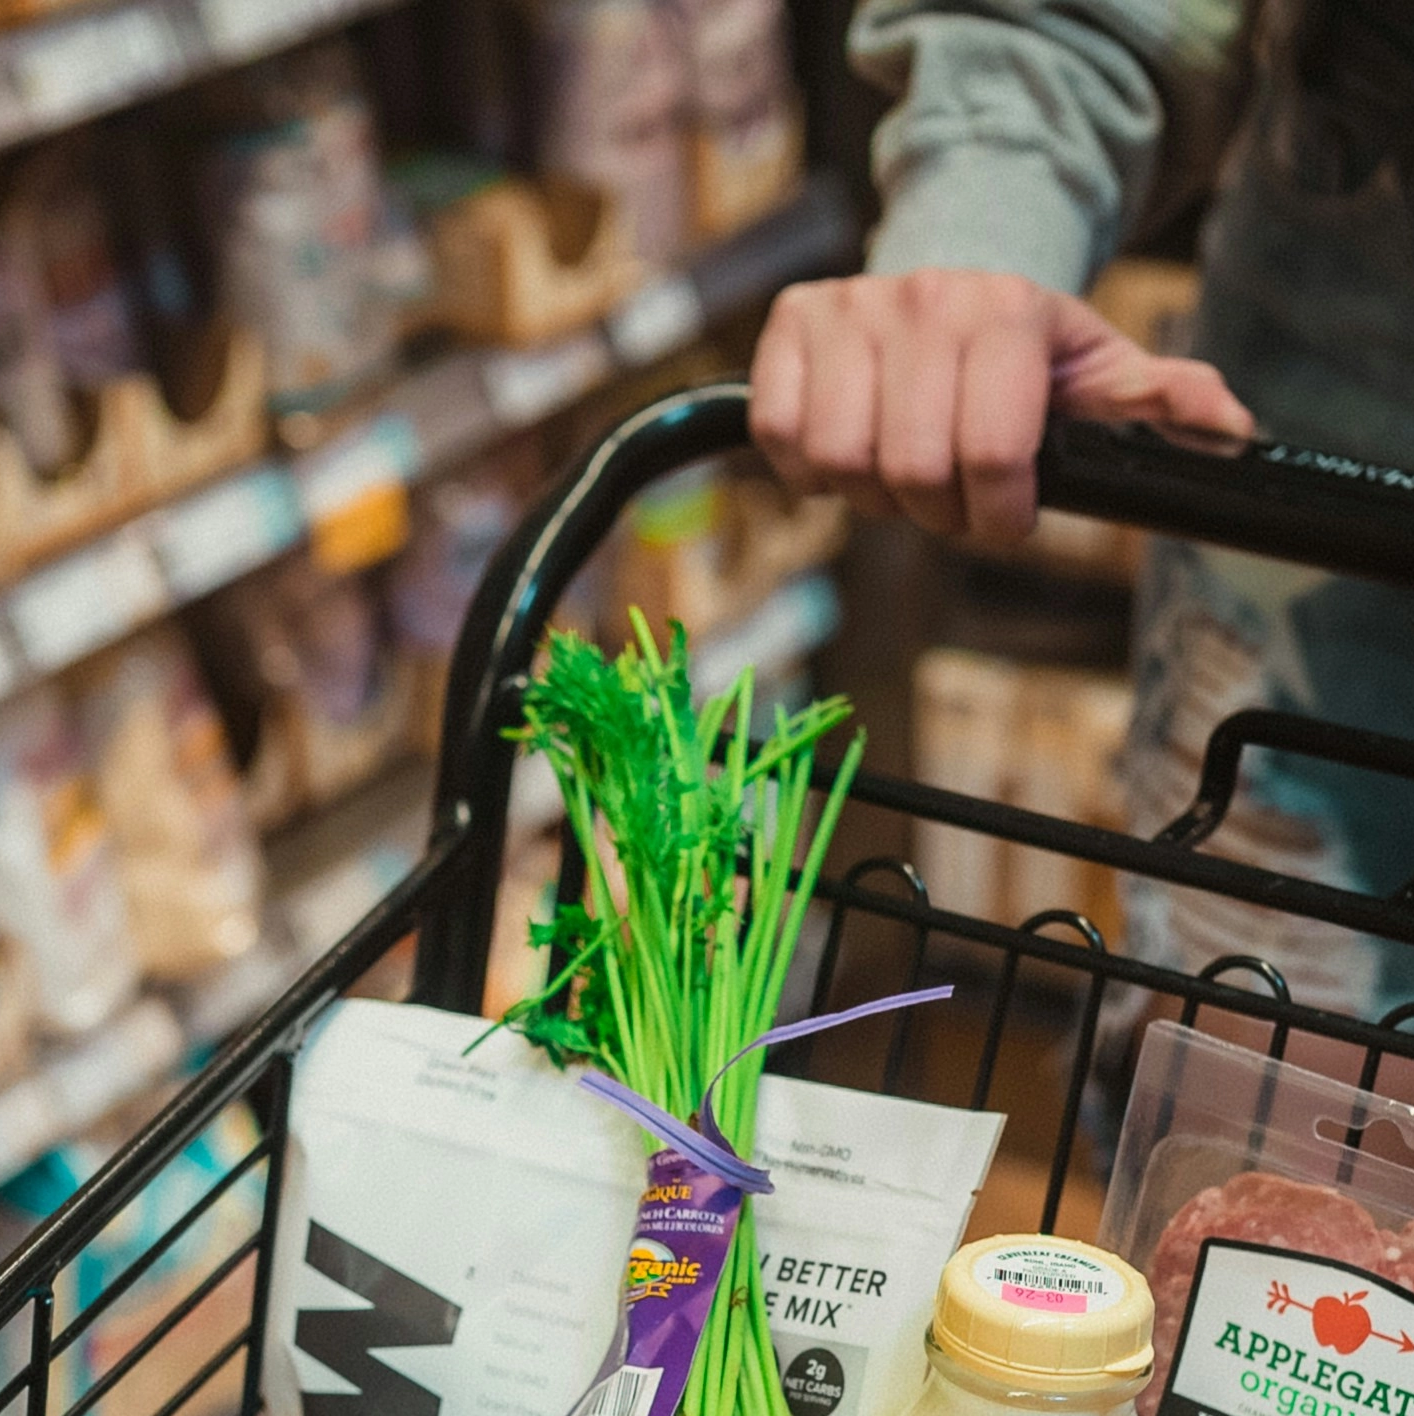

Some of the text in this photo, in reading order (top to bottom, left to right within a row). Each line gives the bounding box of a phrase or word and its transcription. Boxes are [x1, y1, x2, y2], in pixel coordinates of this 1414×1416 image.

[664, 1206, 725, 1224] CARROTS
[776, 1257, 887, 1297] BETTER
[784, 1295, 843, 1329] MIX
[805, 1358, 828, 1382] 2g
[786, 1376, 842, 1399] NET CARBS
